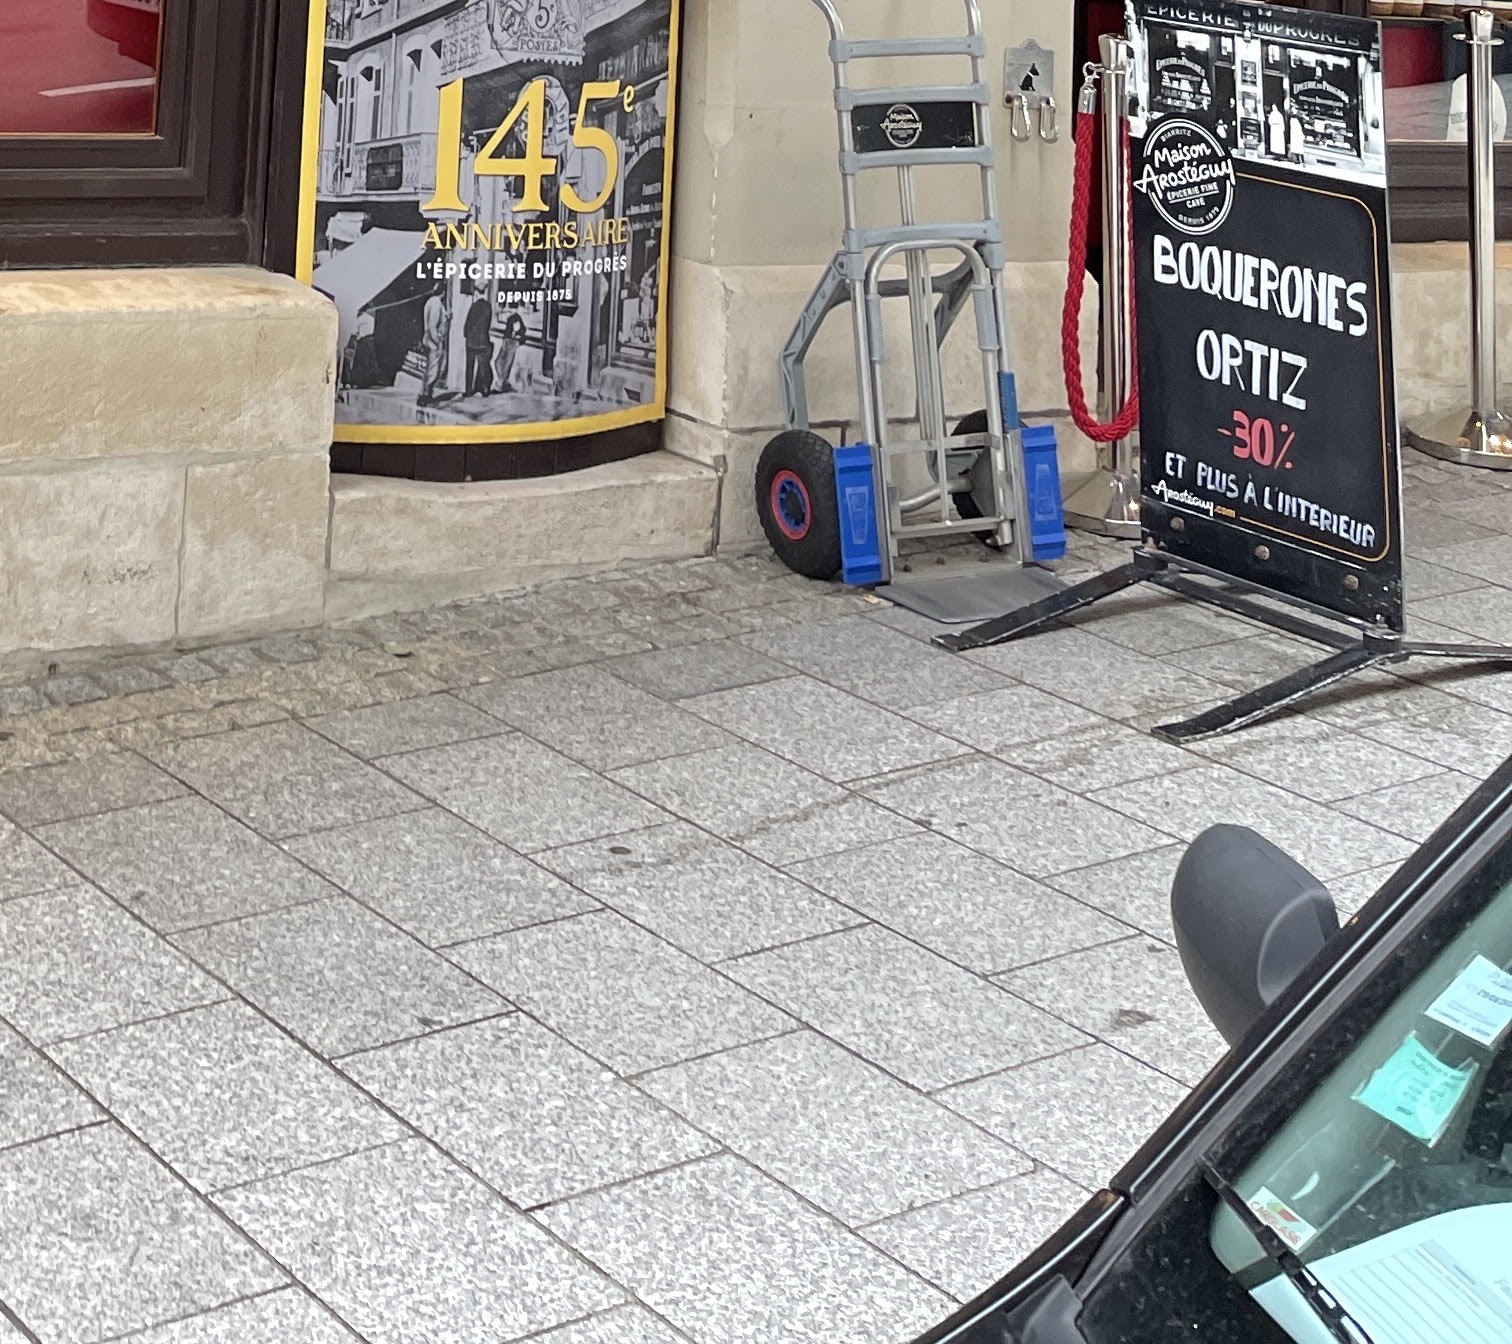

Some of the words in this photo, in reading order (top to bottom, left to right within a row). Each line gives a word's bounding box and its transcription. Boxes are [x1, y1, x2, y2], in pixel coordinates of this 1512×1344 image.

[520, 39, 560, 52] POSTES
[1154, 142, 1212, 168] Maison
[1200, 181, 1219, 193] FINE
[1186, 197, 1206, 209] CAVE
[1178, 213, 1205, 226] DEPUIS
[422, 216, 631, 251] ANNIVERSAIRE
[416, 257, 526, 280] L'ÉPICERIE
[533, 261, 556, 279] DU
[561, 251, 628, 277] PROGRÈS
[497, 290, 543, 304] DEPUIS
[546, 289, 572, 302] 1875
[1153, 234, 1368, 337] BOQUERONES
[1196, 329, 1308, 411] ORTIZ
[1217, 410, 1296, 470] -30%
[1165, 451, 1187, 479] ET
[1196, 461, 1240, 498] PLUS
[1243, 474, 1258, 507] À
